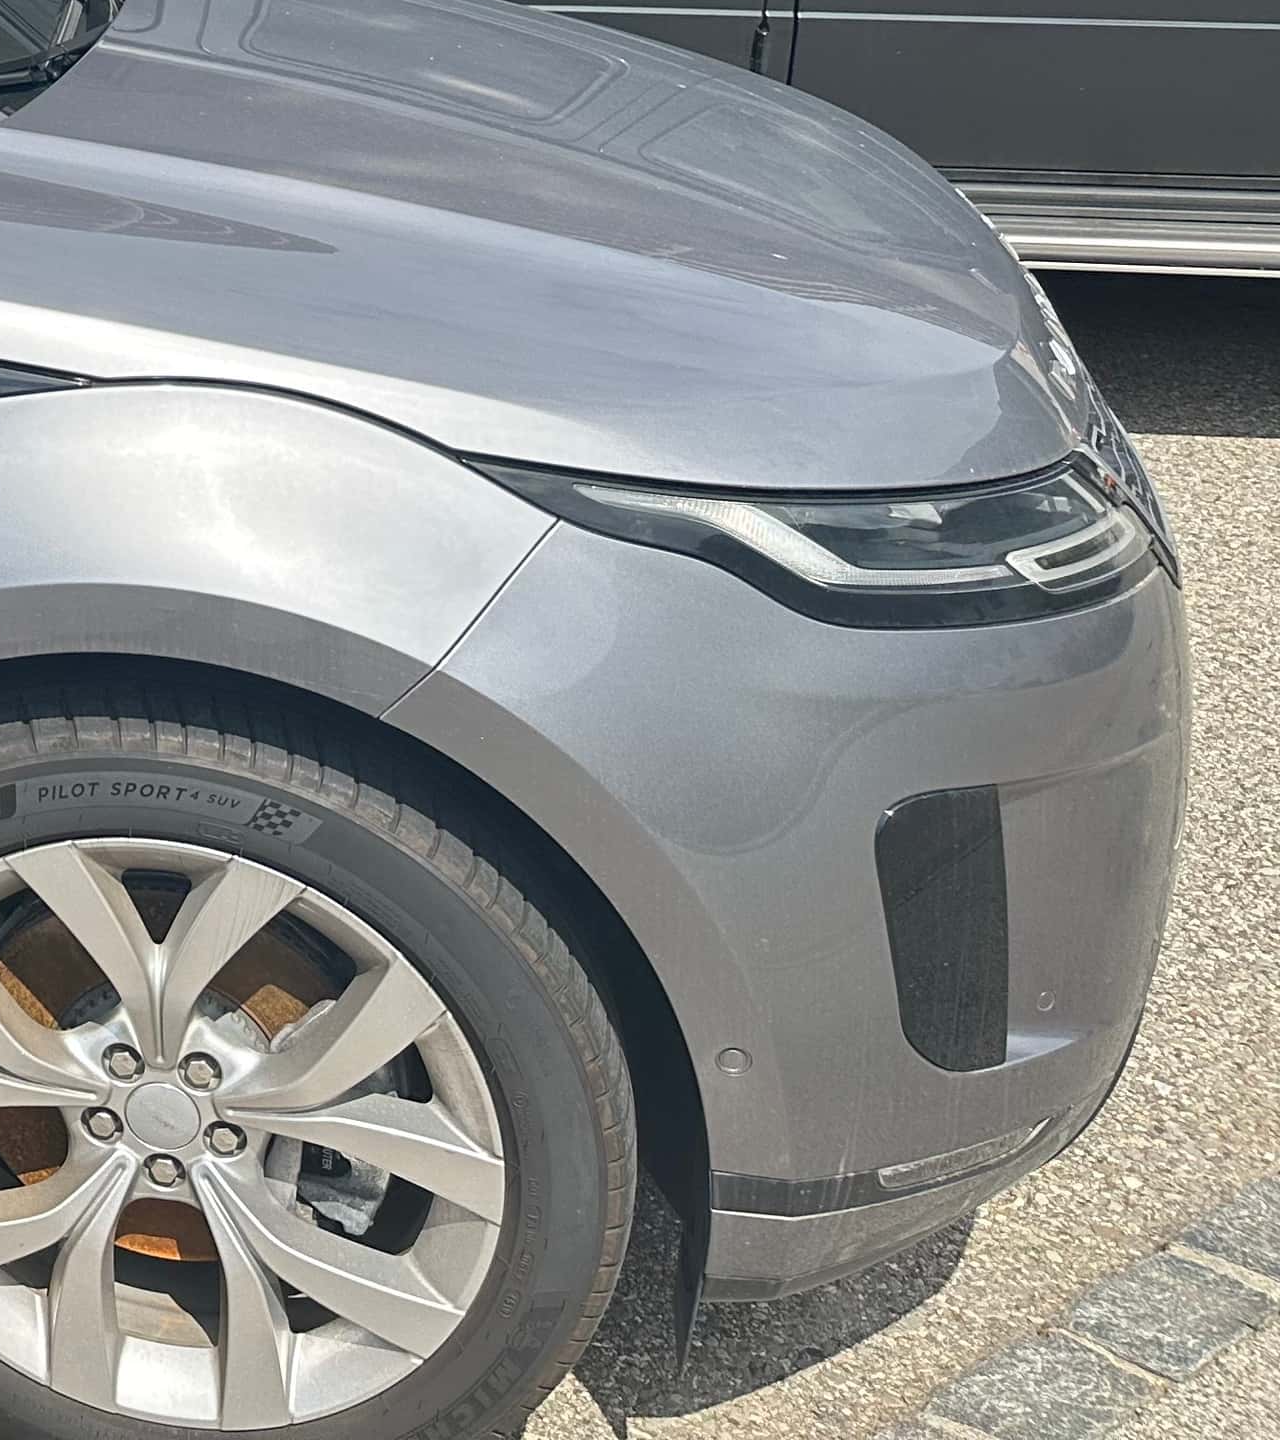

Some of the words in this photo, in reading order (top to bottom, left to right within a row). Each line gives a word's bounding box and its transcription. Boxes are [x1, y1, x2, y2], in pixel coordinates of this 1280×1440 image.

[38, 781, 99, 802] PILOT
[110, 781, 188, 802] SPORT
[189, 790, 201, 801] 4
[206, 793, 241, 809] SUV
